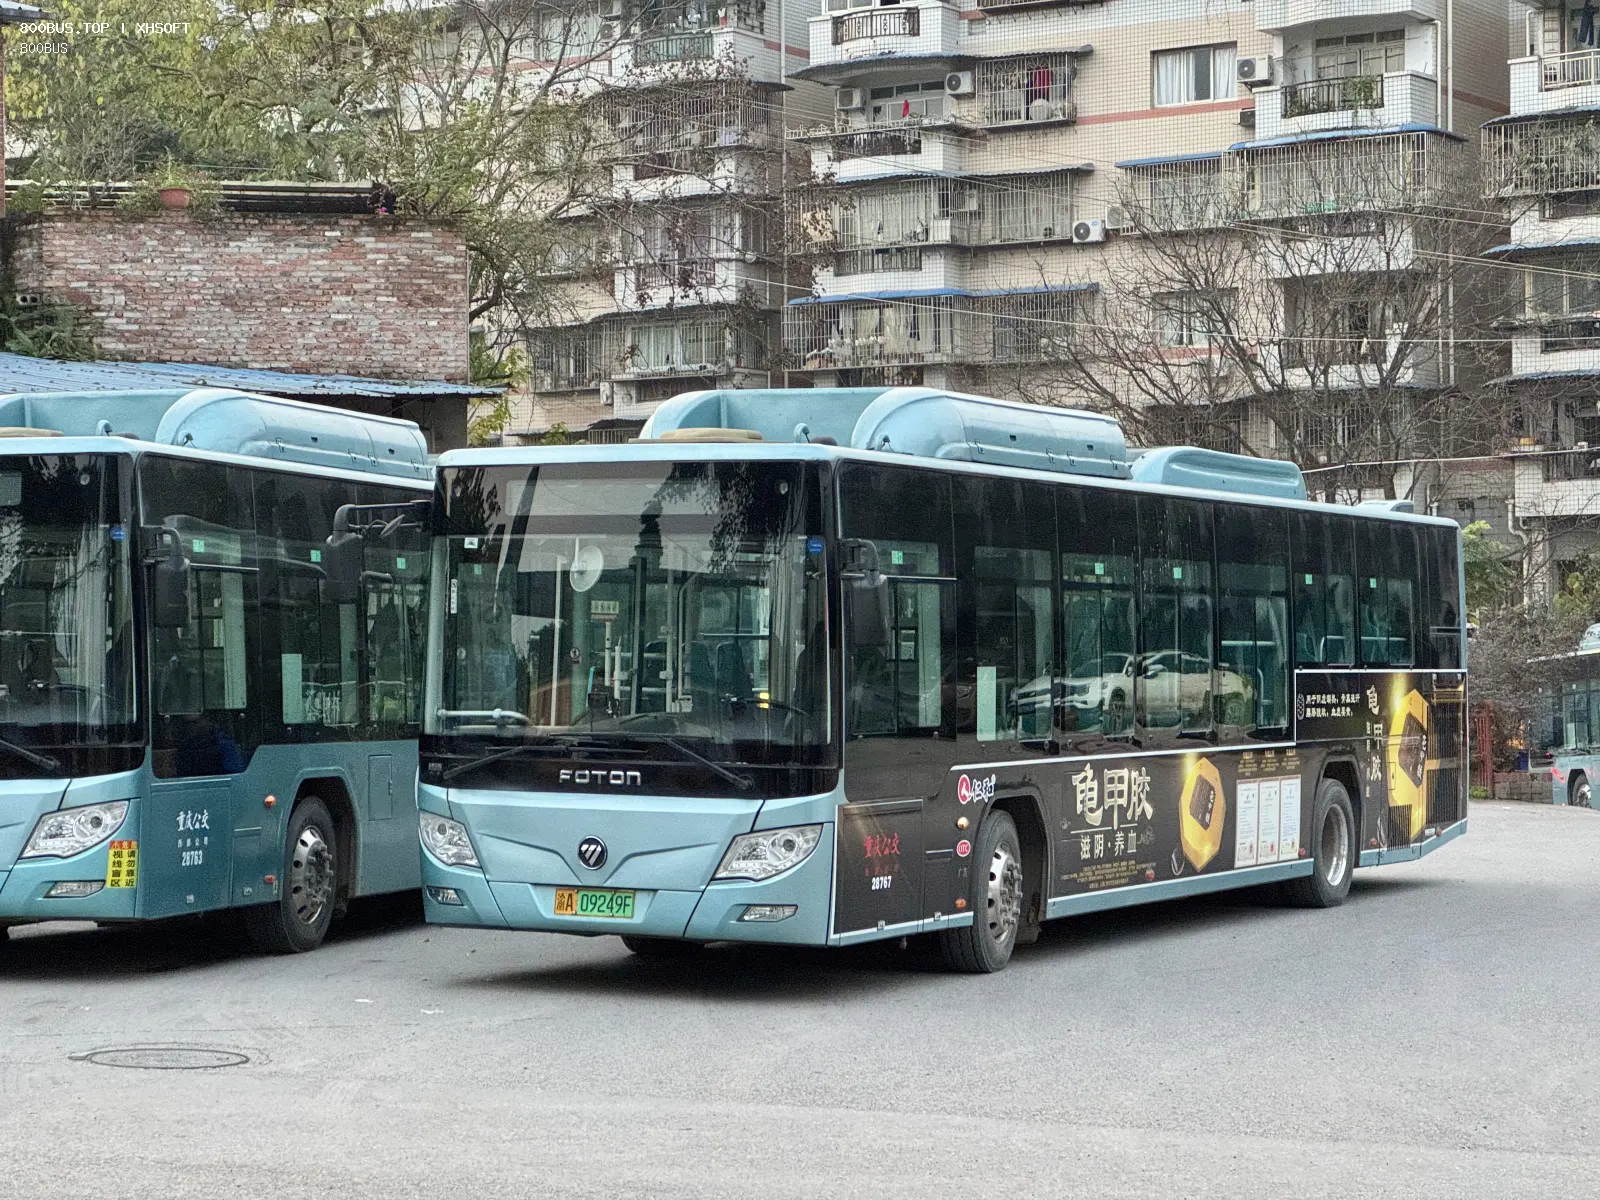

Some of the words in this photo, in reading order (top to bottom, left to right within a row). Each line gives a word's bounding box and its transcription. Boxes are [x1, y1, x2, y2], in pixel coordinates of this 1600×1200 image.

[559, 769, 641, 786] FOTON
[1071, 762, 1154, 830] 龟甲胶
[176, 809, 210, 831] 重庆公交
[871, 876, 892, 890] 28767
